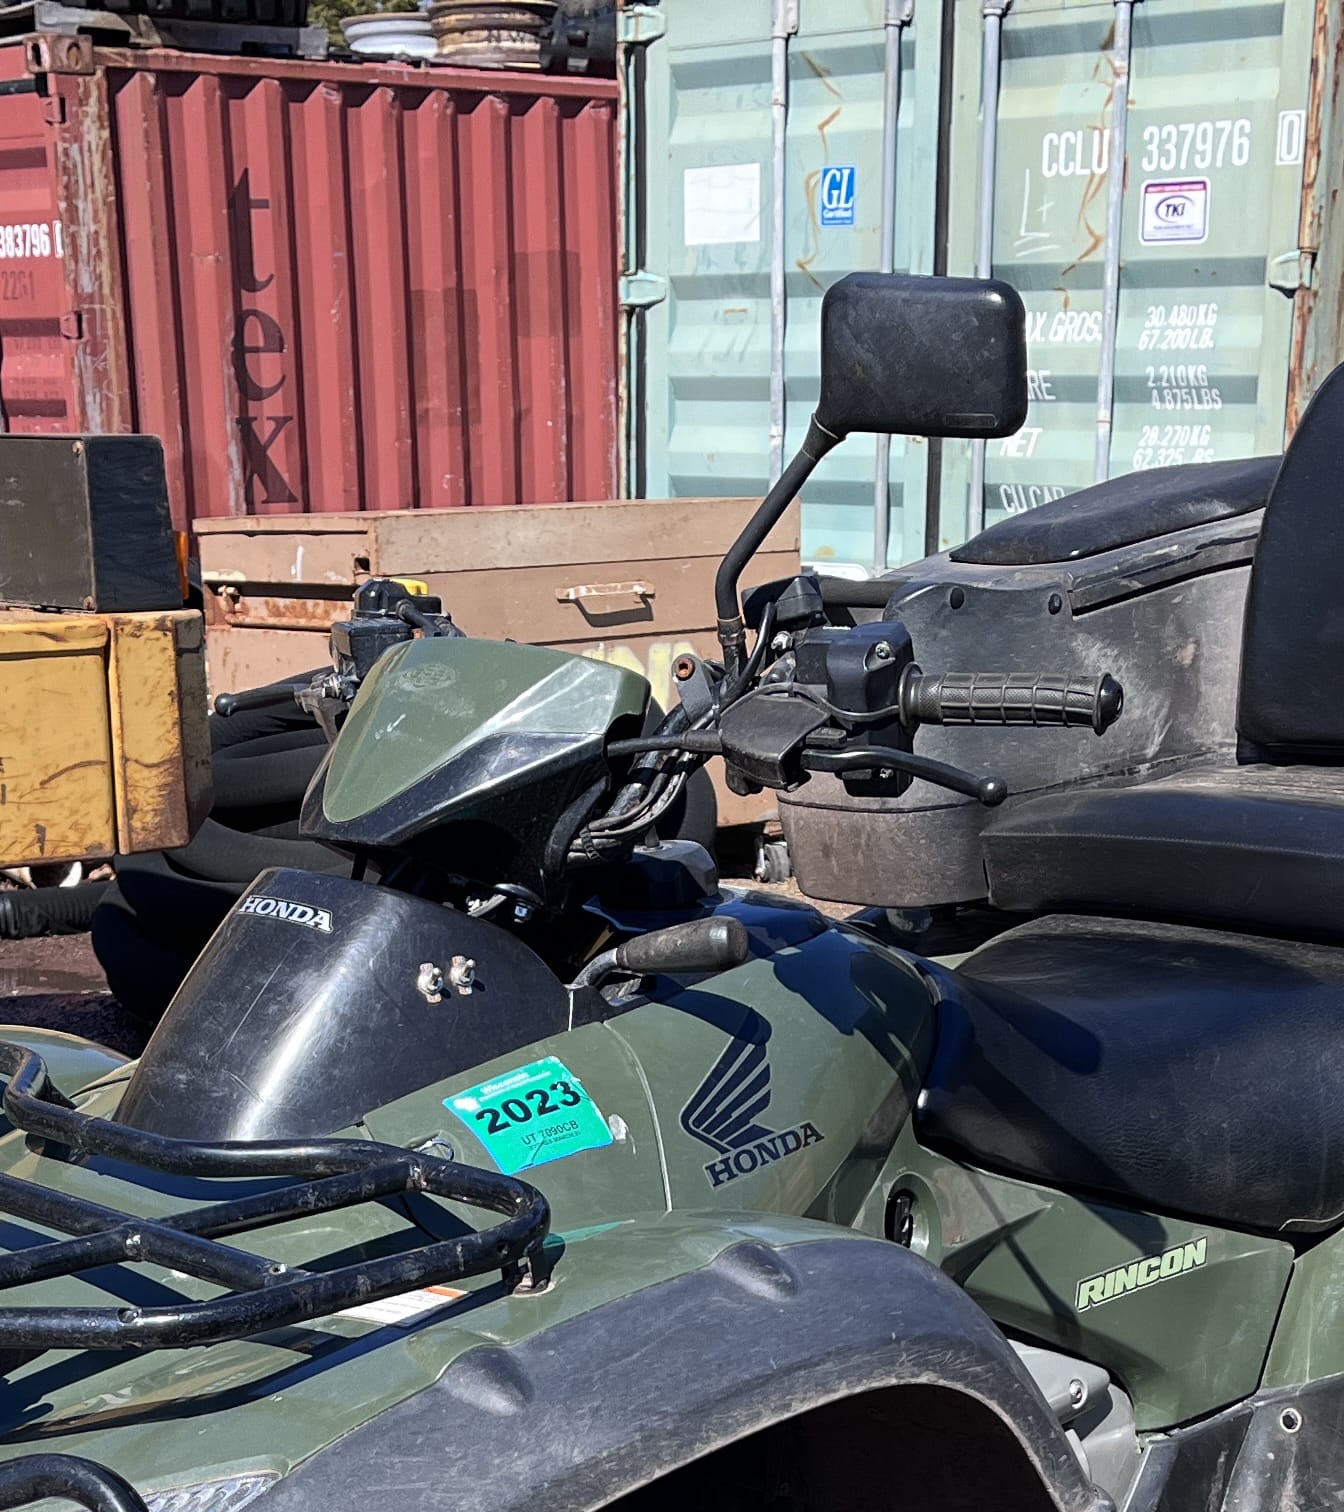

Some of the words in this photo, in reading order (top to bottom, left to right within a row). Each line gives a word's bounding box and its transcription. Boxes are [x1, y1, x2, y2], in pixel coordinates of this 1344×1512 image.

[1042, 129, 1112, 177] CCLU
[1142, 119, 1251, 171] 337976
[823, 168, 854, 209] GL
[227, 167, 299, 504] tex
[239, 896, 332, 932] HONDA
[475, 1080, 582, 1135] 2023
[521, 1134, 537, 1146] UT
[705, 1121, 825, 1188] HONDA
[1076, 1236, 1209, 1311] RINCON
